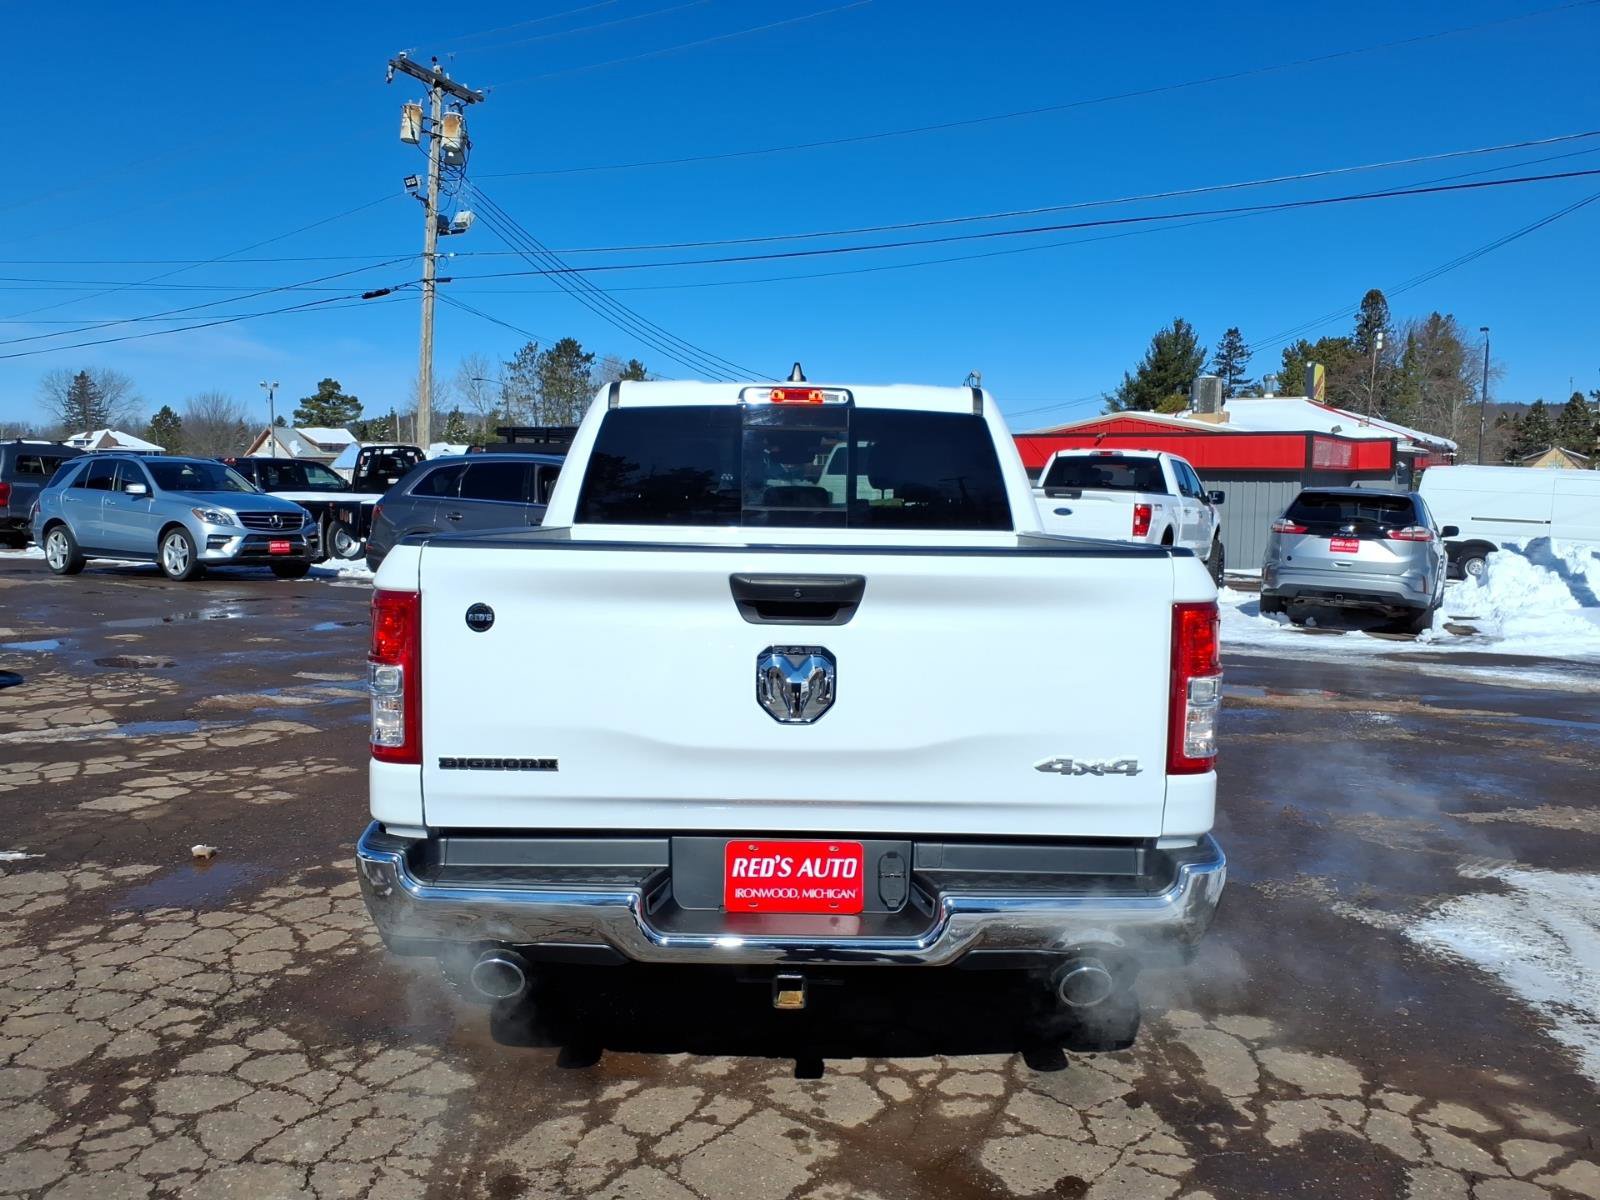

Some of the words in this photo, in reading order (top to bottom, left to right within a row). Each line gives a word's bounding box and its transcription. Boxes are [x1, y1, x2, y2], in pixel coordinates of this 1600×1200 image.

[731, 854, 794, 878] RED'S
[797, 857, 858, 878] AUTO
[735, 887, 800, 900] IRONWOOD,
[802, 888, 856, 899] MICHIGAN
